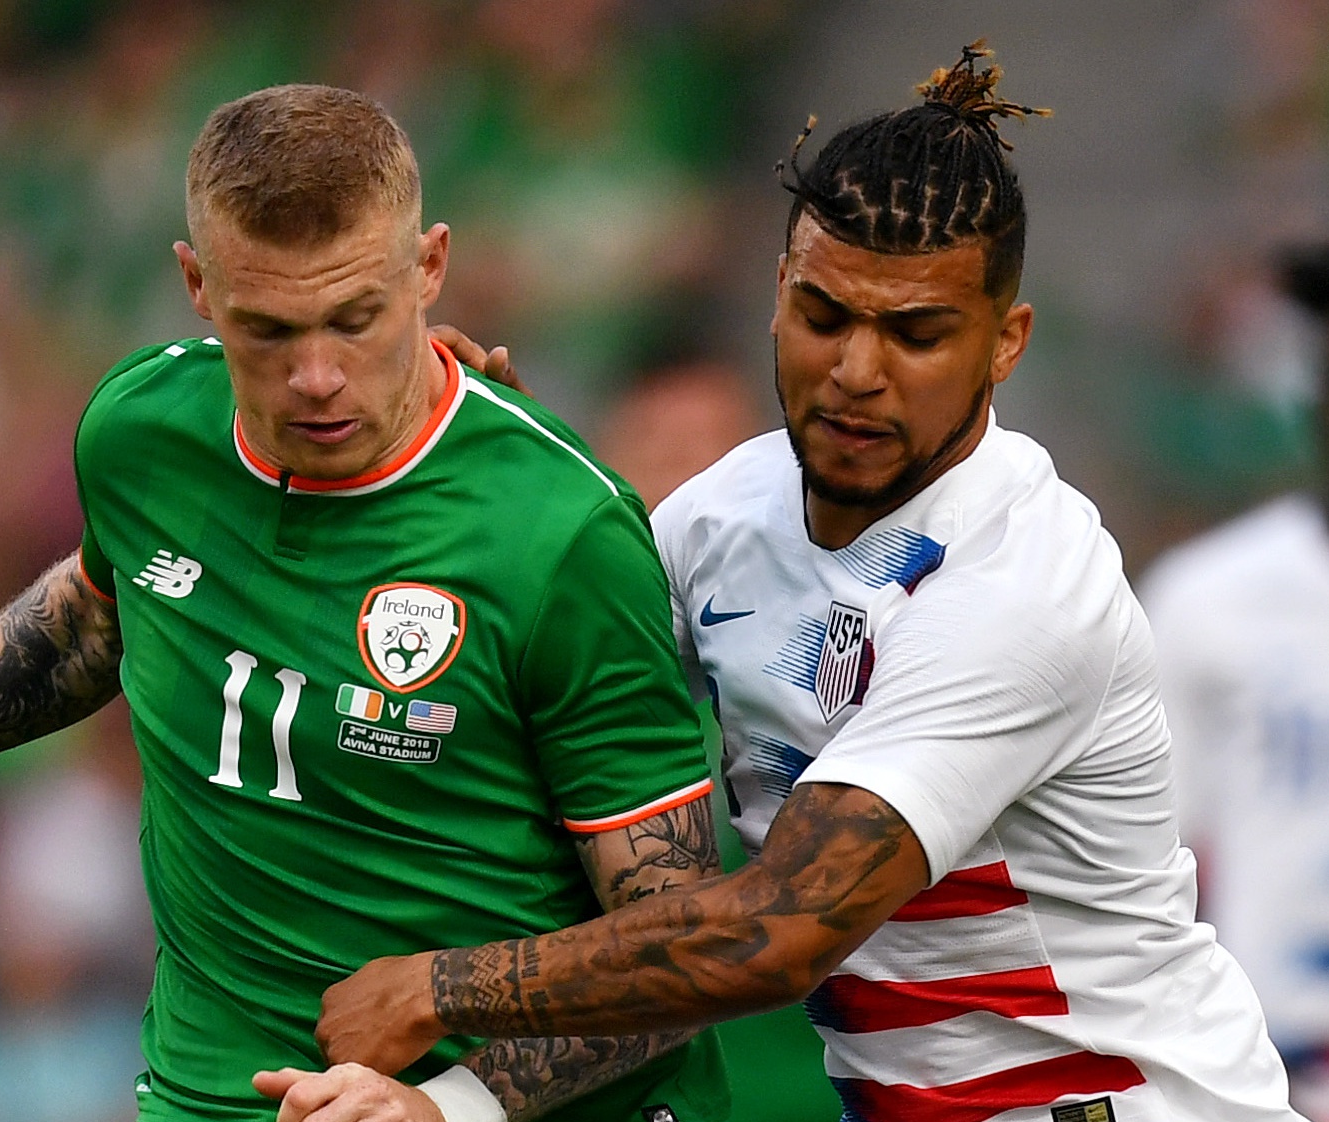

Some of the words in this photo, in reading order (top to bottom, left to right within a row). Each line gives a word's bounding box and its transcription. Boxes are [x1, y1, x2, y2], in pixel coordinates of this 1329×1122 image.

[382, 596, 445, 619] Ireland
[829, 610, 864, 655] USA
[208, 649, 307, 802] 11
[343, 737, 376, 754] AVIVA
[379, 745, 432, 760] STADIUM
[348, 726, 367, 736] 2nd
[368, 731, 400, 746] JUNE
[402, 737, 430, 749] 2018
